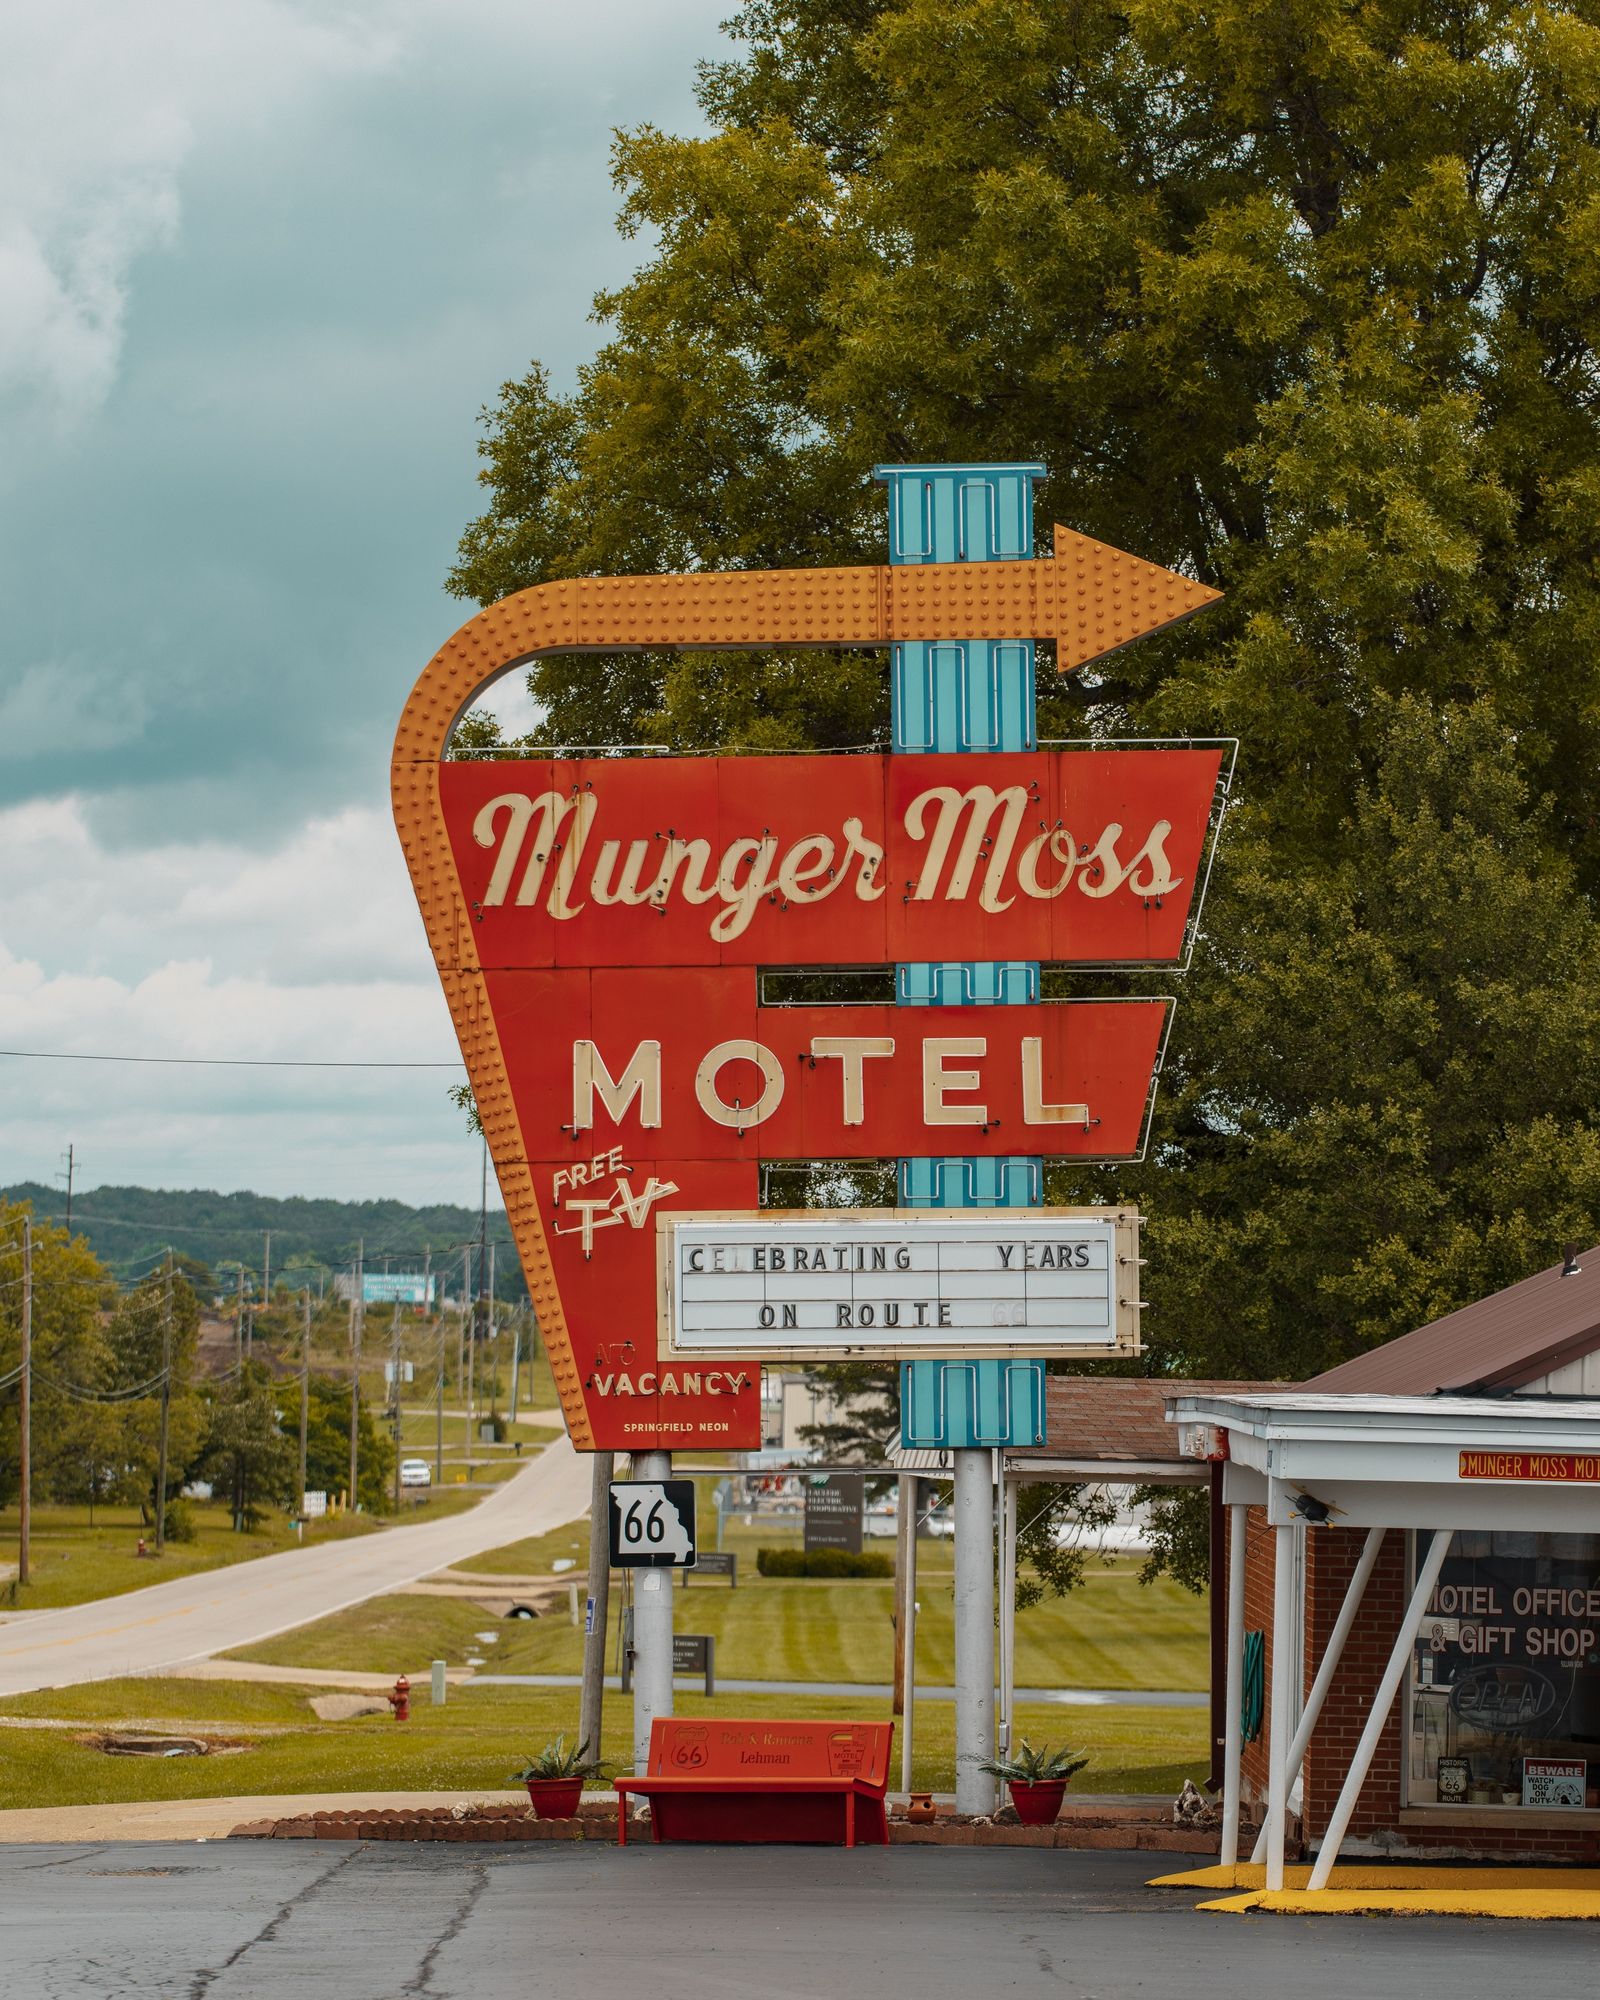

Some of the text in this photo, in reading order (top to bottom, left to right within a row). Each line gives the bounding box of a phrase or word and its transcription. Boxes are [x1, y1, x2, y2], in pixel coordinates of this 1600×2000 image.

[472, 784, 1184, 942] Munger Moss
[573, 1037, 1089, 1129] MOTEL
[553, 1145, 623, 1200] FREE
[565, 1177, 671, 1251] TV
[997, 1243, 1090, 1269] YEARS
[758, 1304, 798, 1328] ON
[836, 1302, 952, 1327] ROUTE
[594, 1372, 747, 1396] VACANCY
[623, 1422, 729, 1432] SPRINGFIELD NEON
[1468, 1455, 1522, 1476] MUNGER
[1529, 1456, 1568, 1477] MOSS
[624, 1499, 665, 1544] 66
[1512, 1587, 1600, 1618] OFFICE
[1429, 1624, 1596, 1657] & GIFT SHOP
[1457, 1681, 1547, 1714] OPEN
[676, 1745, 702, 1765] 66
[740, 1751, 790, 1764] Lehman
[1439, 1759, 1467, 1767] HISTORIC
[1527, 1776, 1554, 1785] WATCH
[1528, 1765, 1582, 1777] BEWARE
[1446, 1779, 1460, 1790] 66
[1529, 1796, 1551, 1804] DUTY
